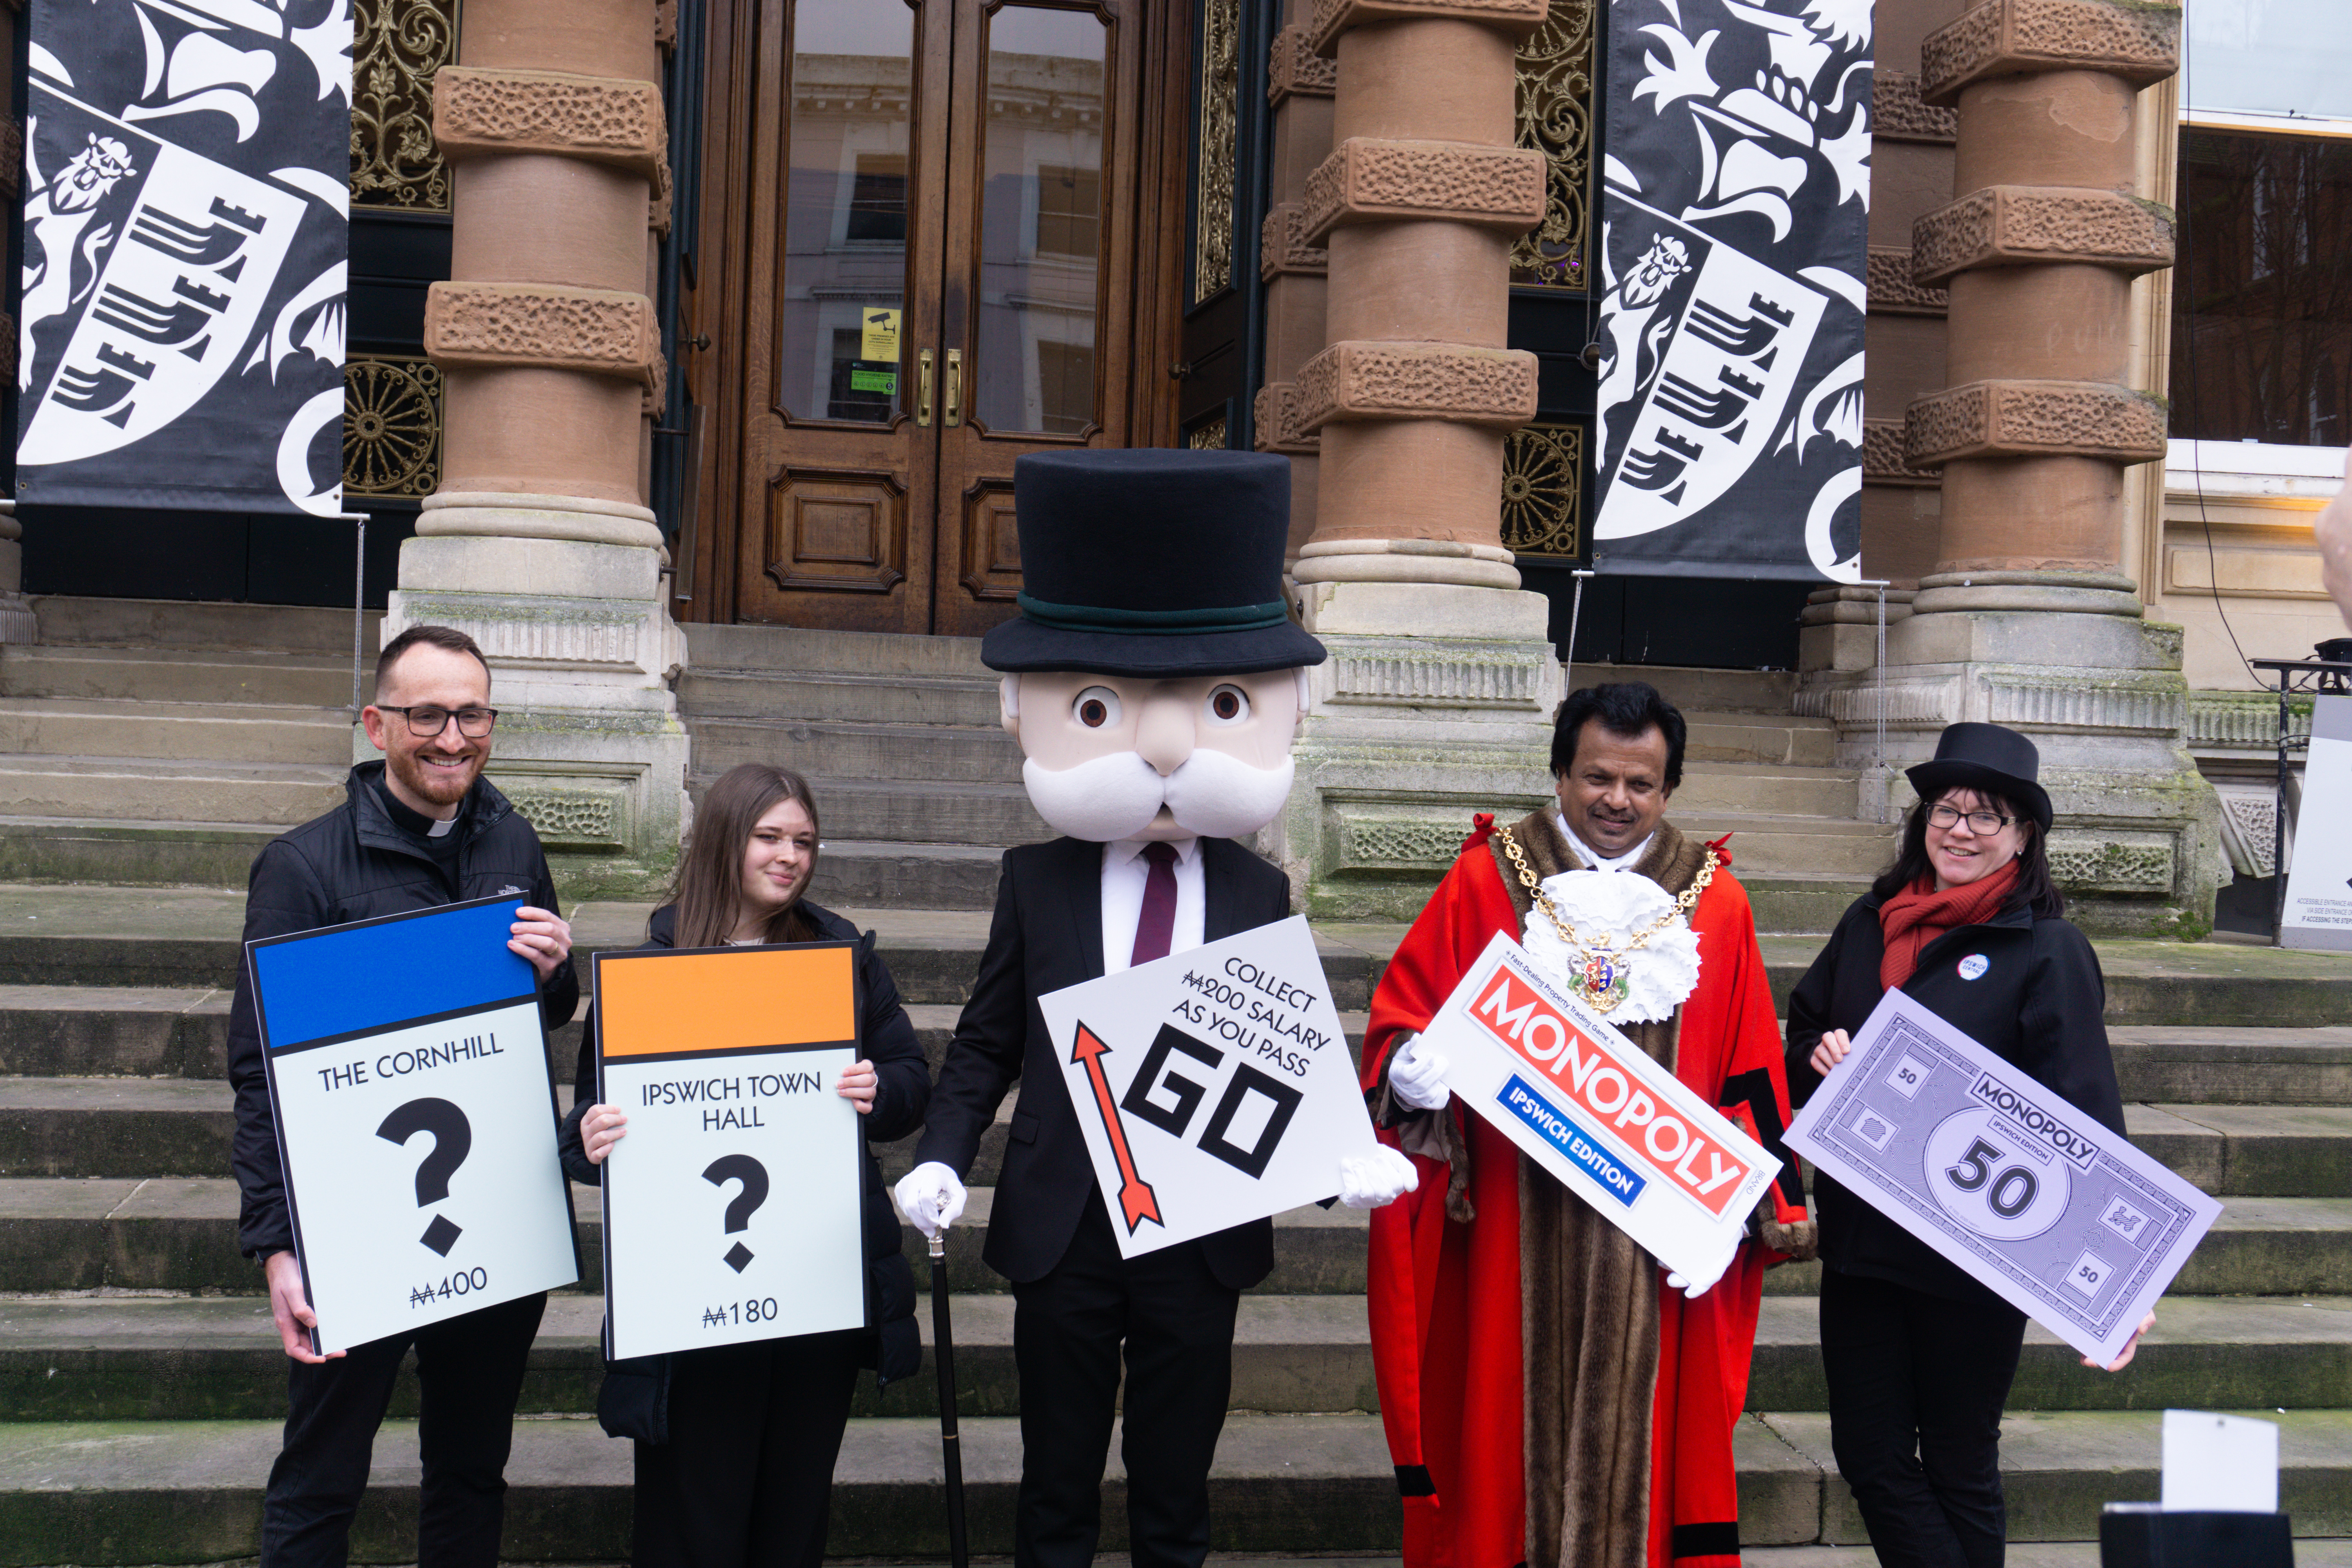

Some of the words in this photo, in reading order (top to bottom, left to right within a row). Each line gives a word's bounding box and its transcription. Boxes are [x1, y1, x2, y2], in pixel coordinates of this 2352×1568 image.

[1224, 957, 1317, 1013] COLLECT
[1962, 965, 1980, 974] CENTRAL
[1963, 959, 1986, 970] IPSWICH
[1510, 954, 1544, 987] Fast-Dealing
[1544, 984, 1570, 1008] Property
[1570, 1005, 1592, 1027] Trading
[1592, 1024, 1610, 1041] Game
[1172, 998, 1206, 1024] AS
[1207, 1011, 1256, 1049] YOU
[1257, 1038, 1310, 1077] PASS
[1247, 1000, 1331, 1051] SALARY
[318, 1061, 368, 1092] THE
[376, 1033, 504, 1078] CORNHILL
[642, 1077, 740, 1106] IPSWICH
[747, 1071, 821, 1096] TOWN
[1480, 977, 1741, 1196] MONOPOLY
[1898, 1067, 1917, 1084] 50
[703, 1106, 765, 1131] HALL
[1120, 1022, 1304, 1181] GO
[1978, 1079, 2094, 1161] MONOPOLY
[1508, 1086, 1572, 1145] IPSWICH
[1569, 1137, 1634, 1196] EDITION
[1993, 1120, 2021, 1142] IPSWICH
[2020, 1139, 2049, 1160] EDITION
[1746, 1170, 1766, 1194] BRAND
[1945, 1134, 2039, 1220] 50
[2079, 1265, 2098, 1283] 50
